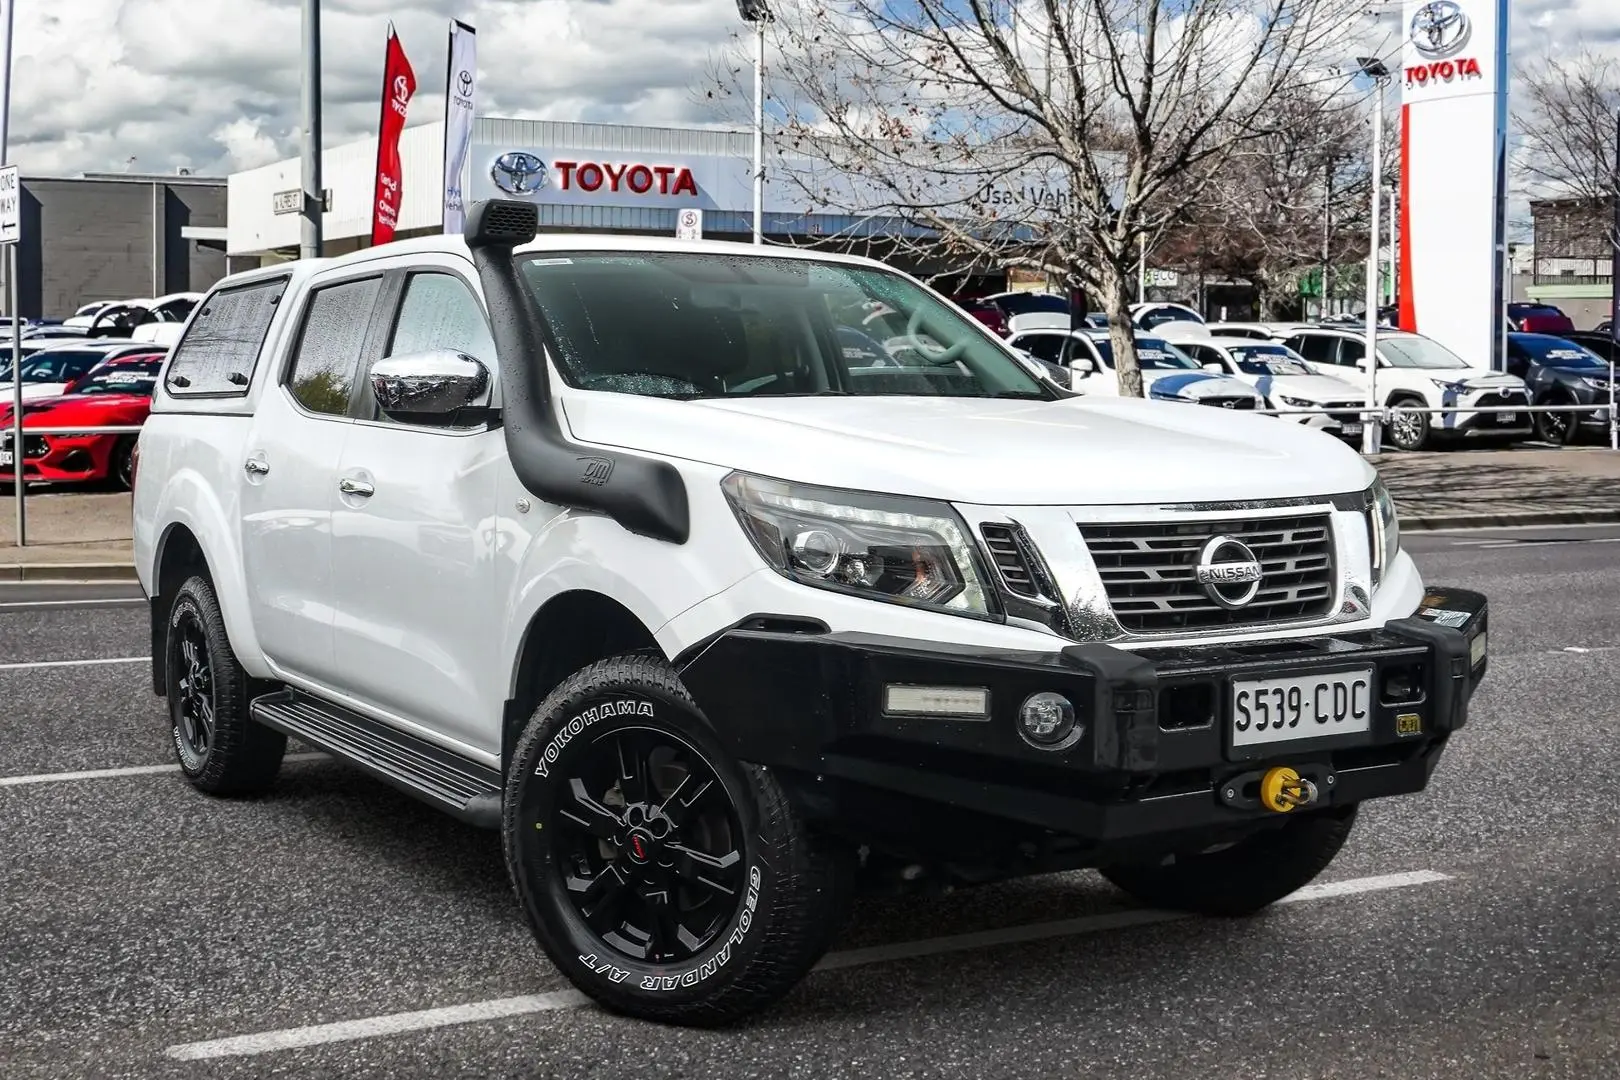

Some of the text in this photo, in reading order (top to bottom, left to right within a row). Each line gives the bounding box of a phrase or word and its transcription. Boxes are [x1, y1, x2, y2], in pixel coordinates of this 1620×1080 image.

[1404, 58, 1480, 83] TOYOTA
[554, 161, 698, 196] TOYOTA
[0, 196, 16, 213] WAY
[979, 182, 1025, 204] Used
[1209, 565, 1261, 580] NISSAN
[534, 700, 654, 778] YOKOHAMA
[578, 866, 761, 991] GEOLANDAR A/T
